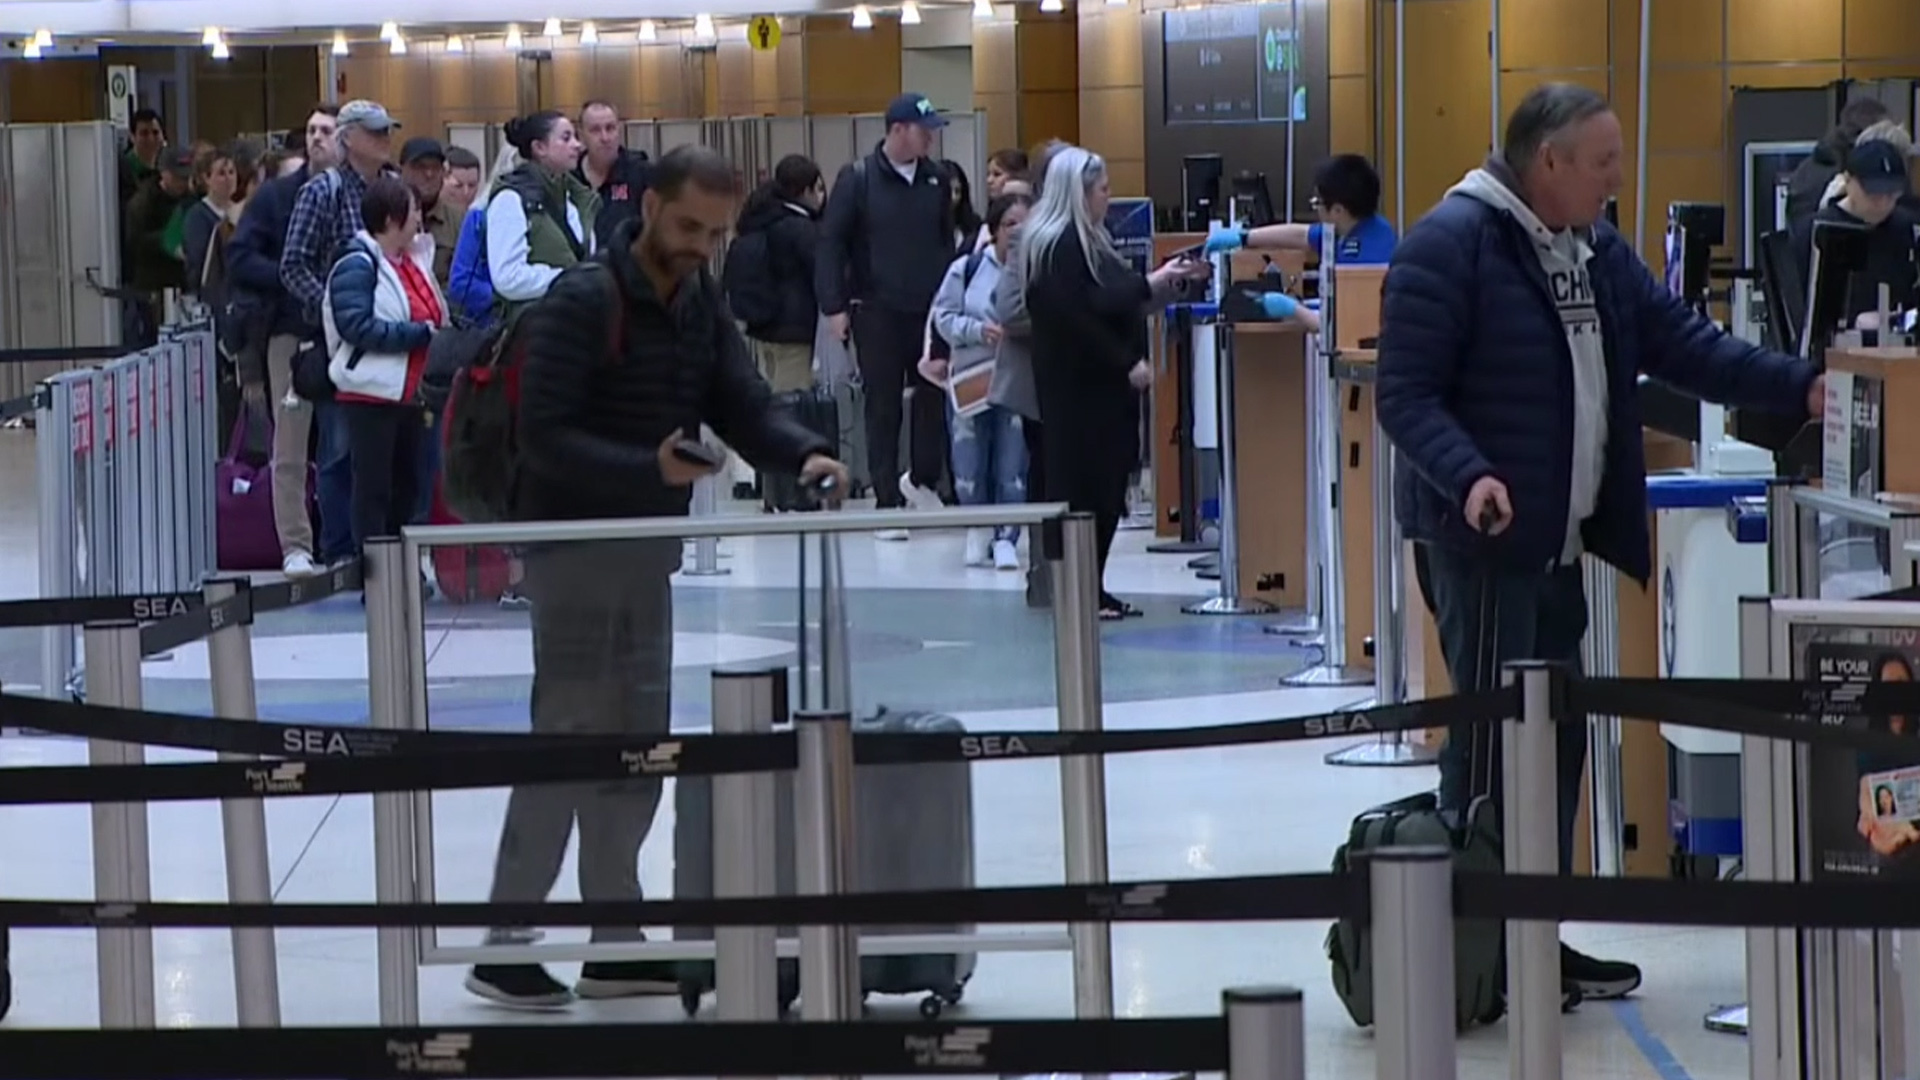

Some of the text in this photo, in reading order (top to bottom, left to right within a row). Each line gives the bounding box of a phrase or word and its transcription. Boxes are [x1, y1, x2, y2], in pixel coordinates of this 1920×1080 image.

[133, 598, 188, 618] SEA
[1820, 658, 1869, 674] BE YOUR
[1303, 712, 1374, 736] SEA
[282, 728, 350, 757] SEA
[960, 735, 1029, 757] SEA
[386, 1039, 419, 1056] Port
[905, 1034, 938, 1051] Port
